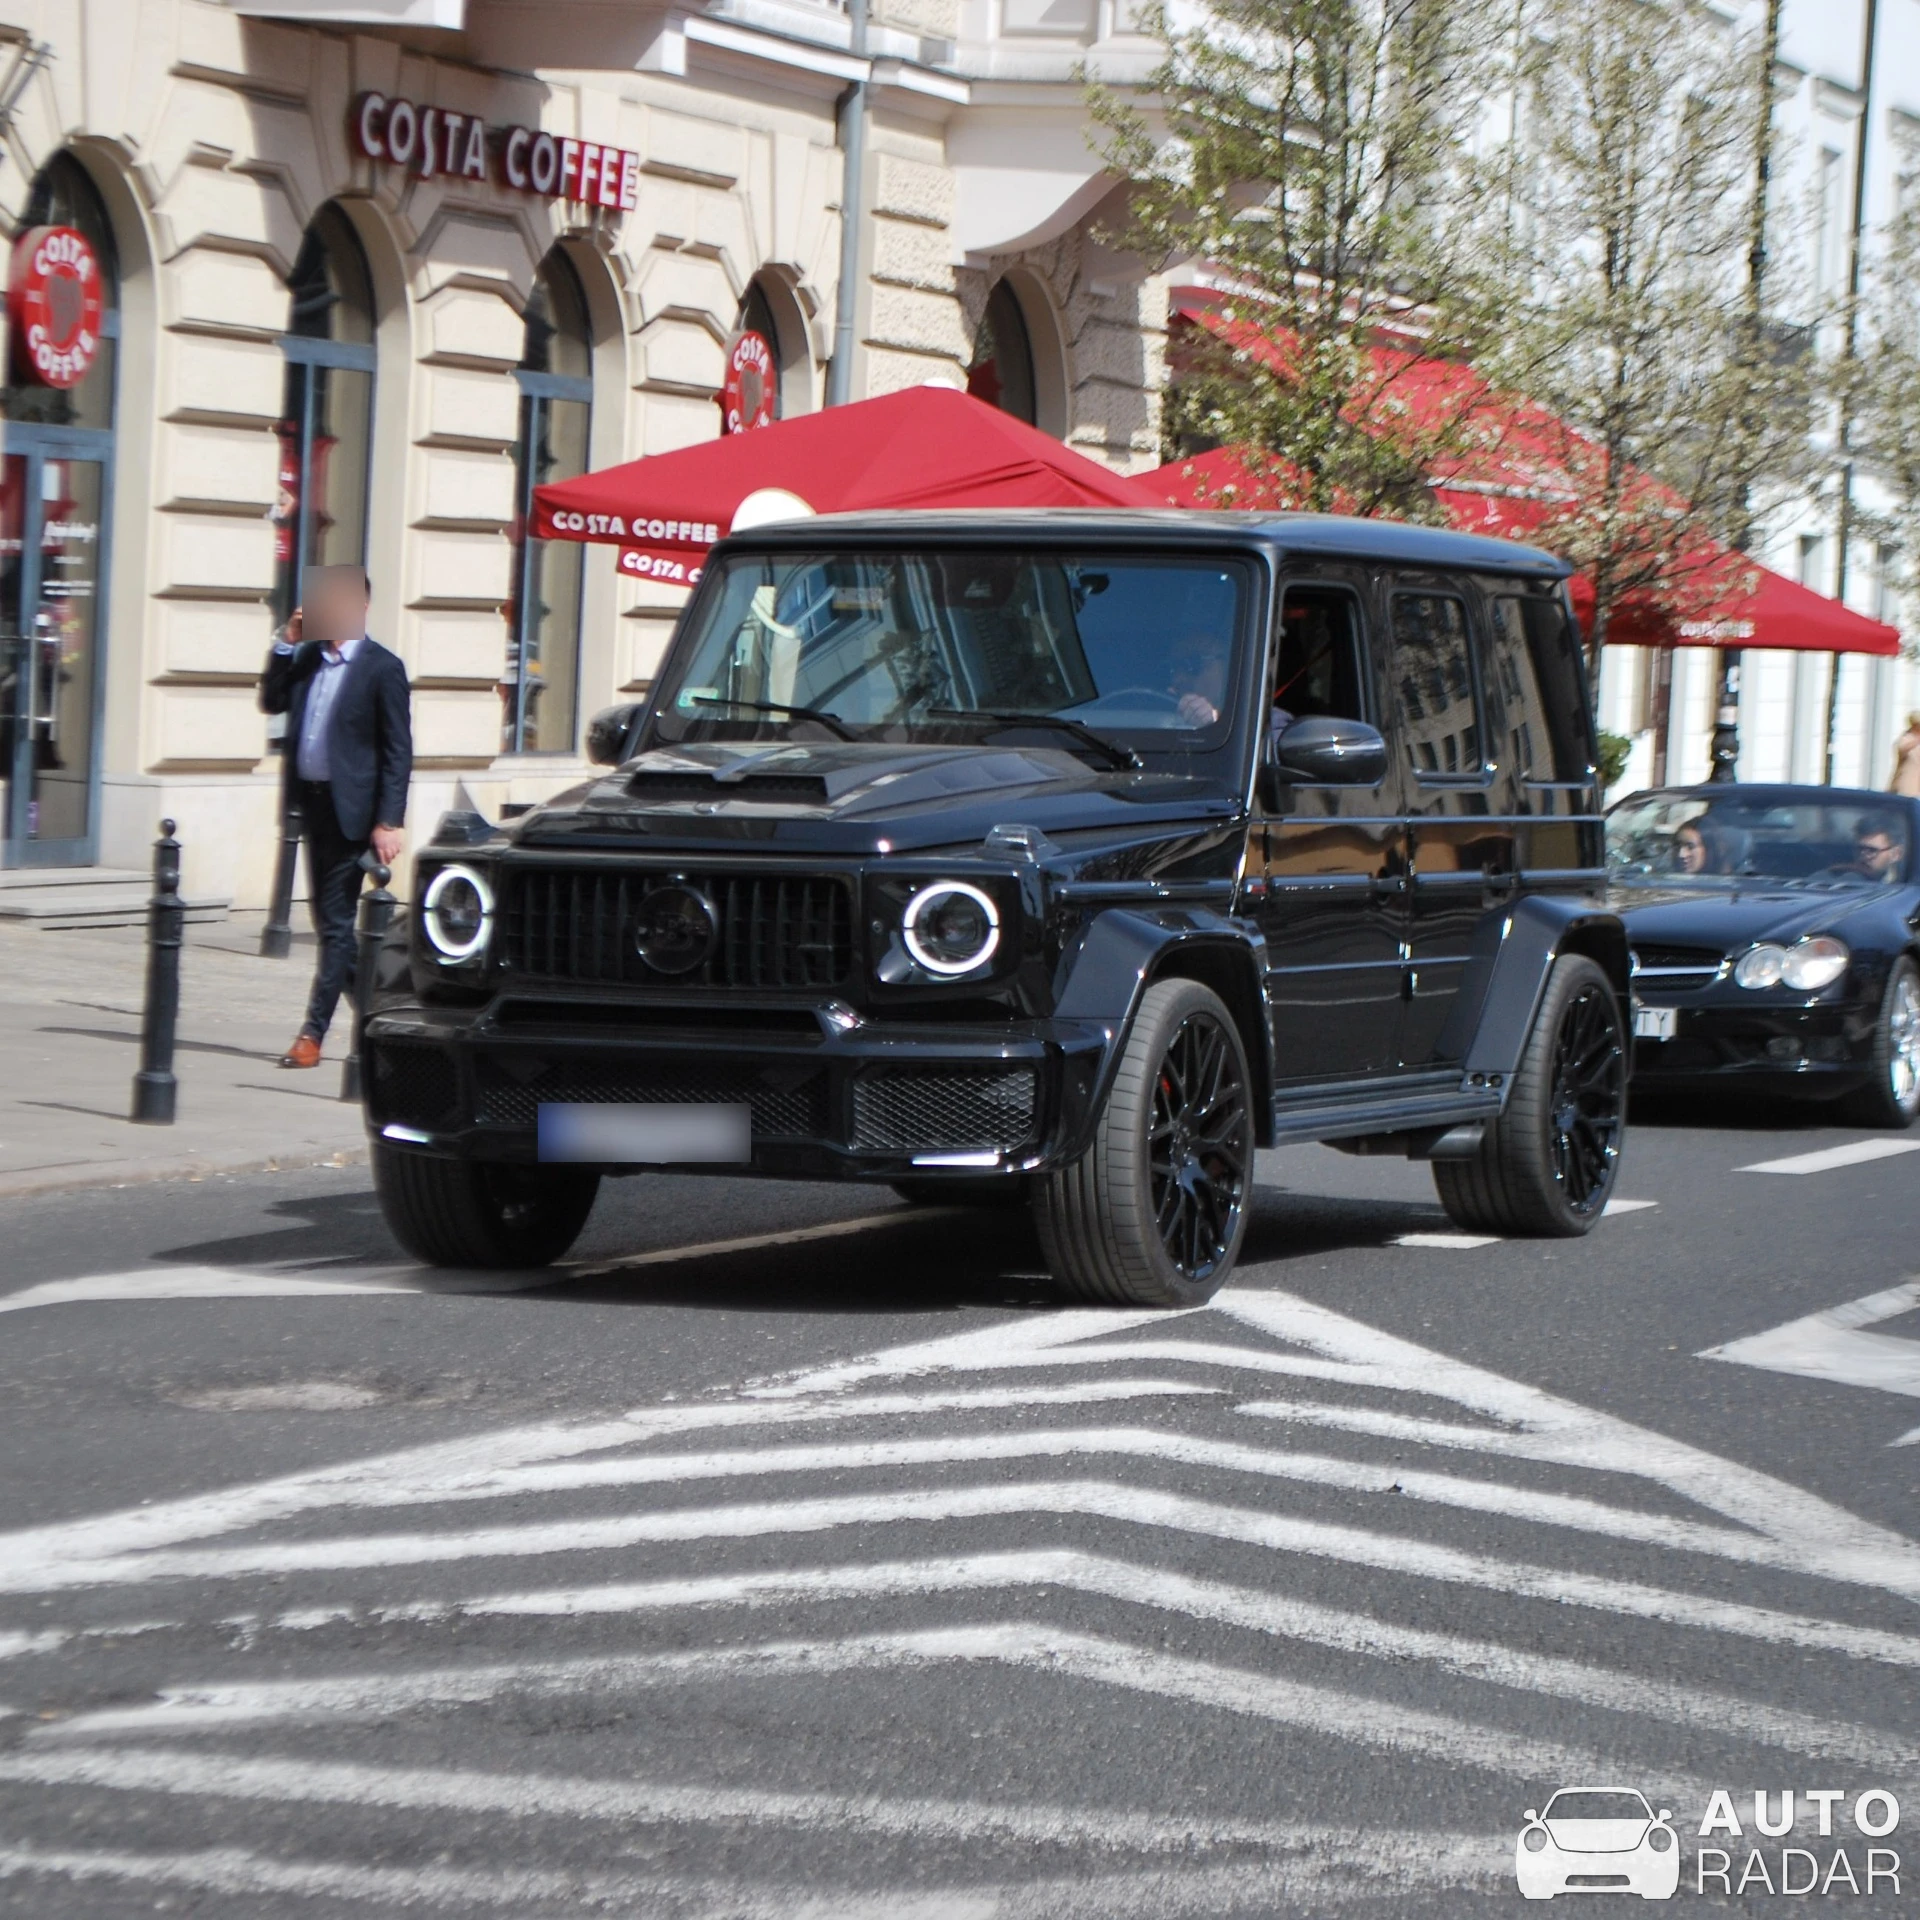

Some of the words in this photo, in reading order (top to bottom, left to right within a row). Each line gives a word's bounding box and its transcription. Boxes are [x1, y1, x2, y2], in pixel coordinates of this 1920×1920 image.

[360, 92, 486, 178] COSTA
[506, 127, 639, 209] COFFEE
[34, 233, 92, 283] COSTA
[28, 323, 95, 381] COFFEE
[733, 335, 769, 376] COSTA
[551, 510, 626, 536] COSTA
[631, 517, 719, 544] COFFEE
[622, 551, 684, 580] COSTA
